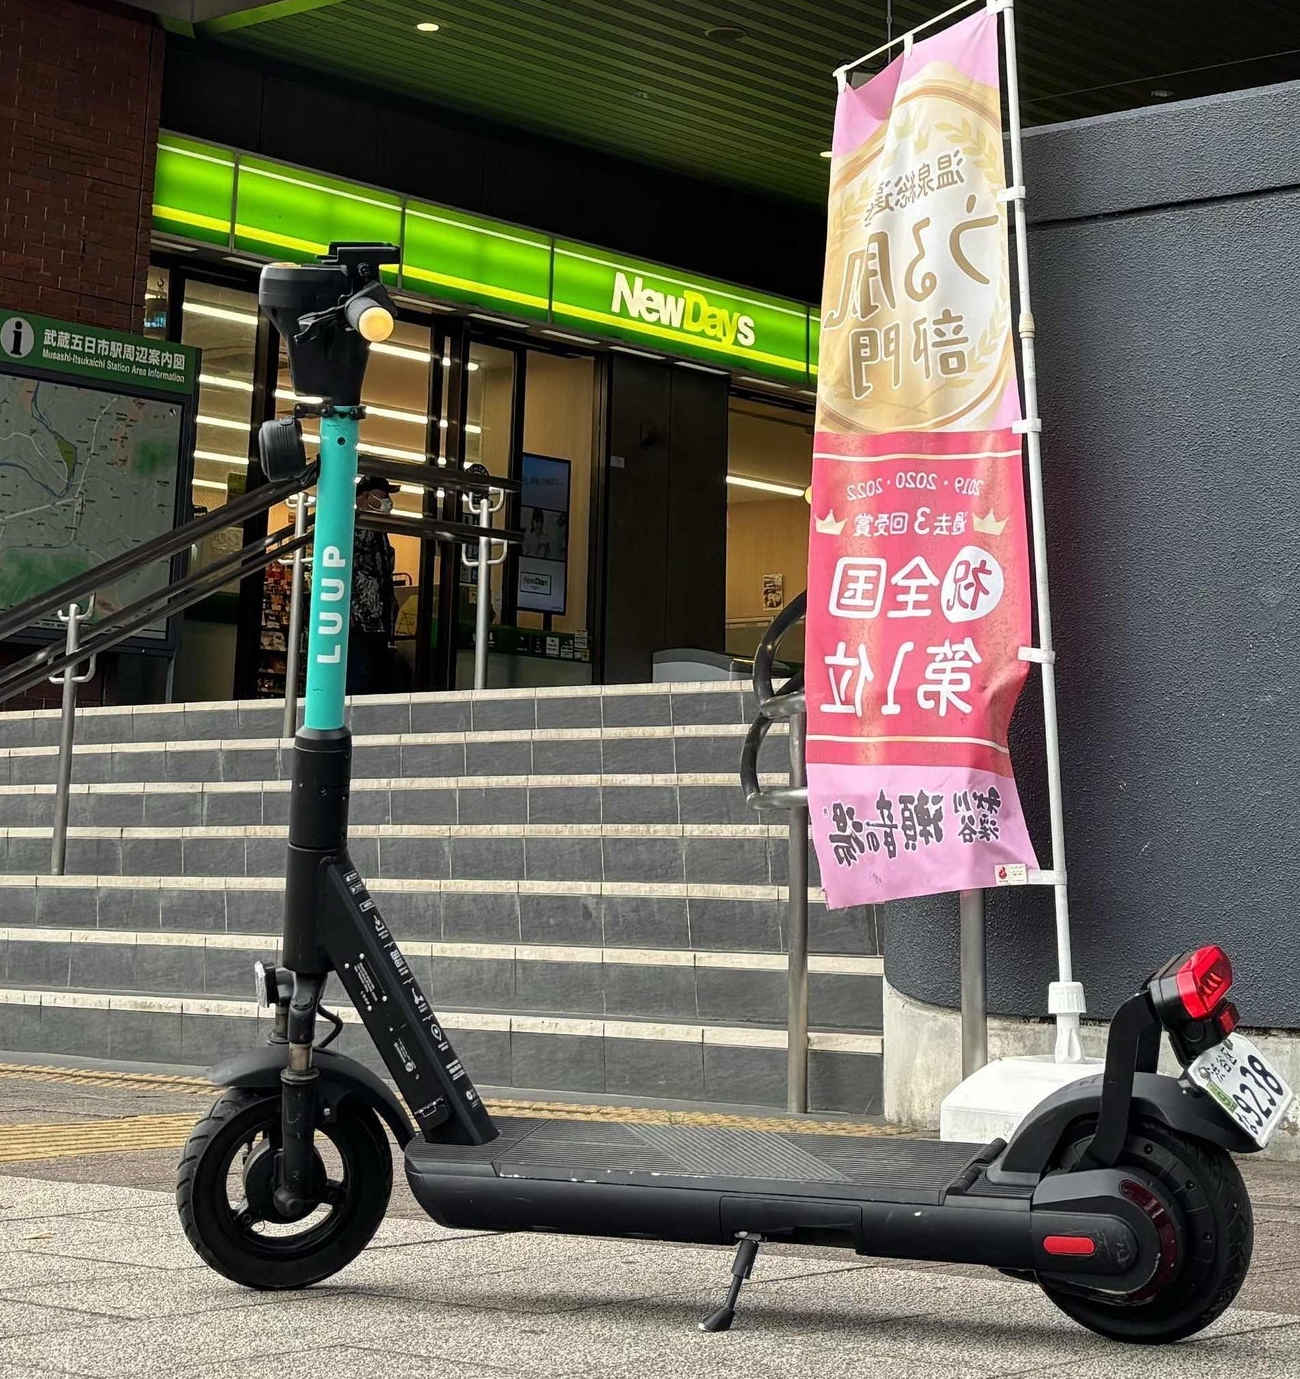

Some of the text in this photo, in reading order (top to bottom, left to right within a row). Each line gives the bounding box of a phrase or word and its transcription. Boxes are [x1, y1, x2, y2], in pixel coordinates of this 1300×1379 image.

[611, 272, 755, 347] NewDays
[42, 348, 185, 383] Musashi-Itsukaichi Station Area Information
[43, 328, 185, 370] 武蔵五日市駅周辺案内図
[316, 545, 346, 663] LUUP
[1207, 1047, 1237, 1083] 渋谷区
[1232, 1054, 1284, 1127] 9238
